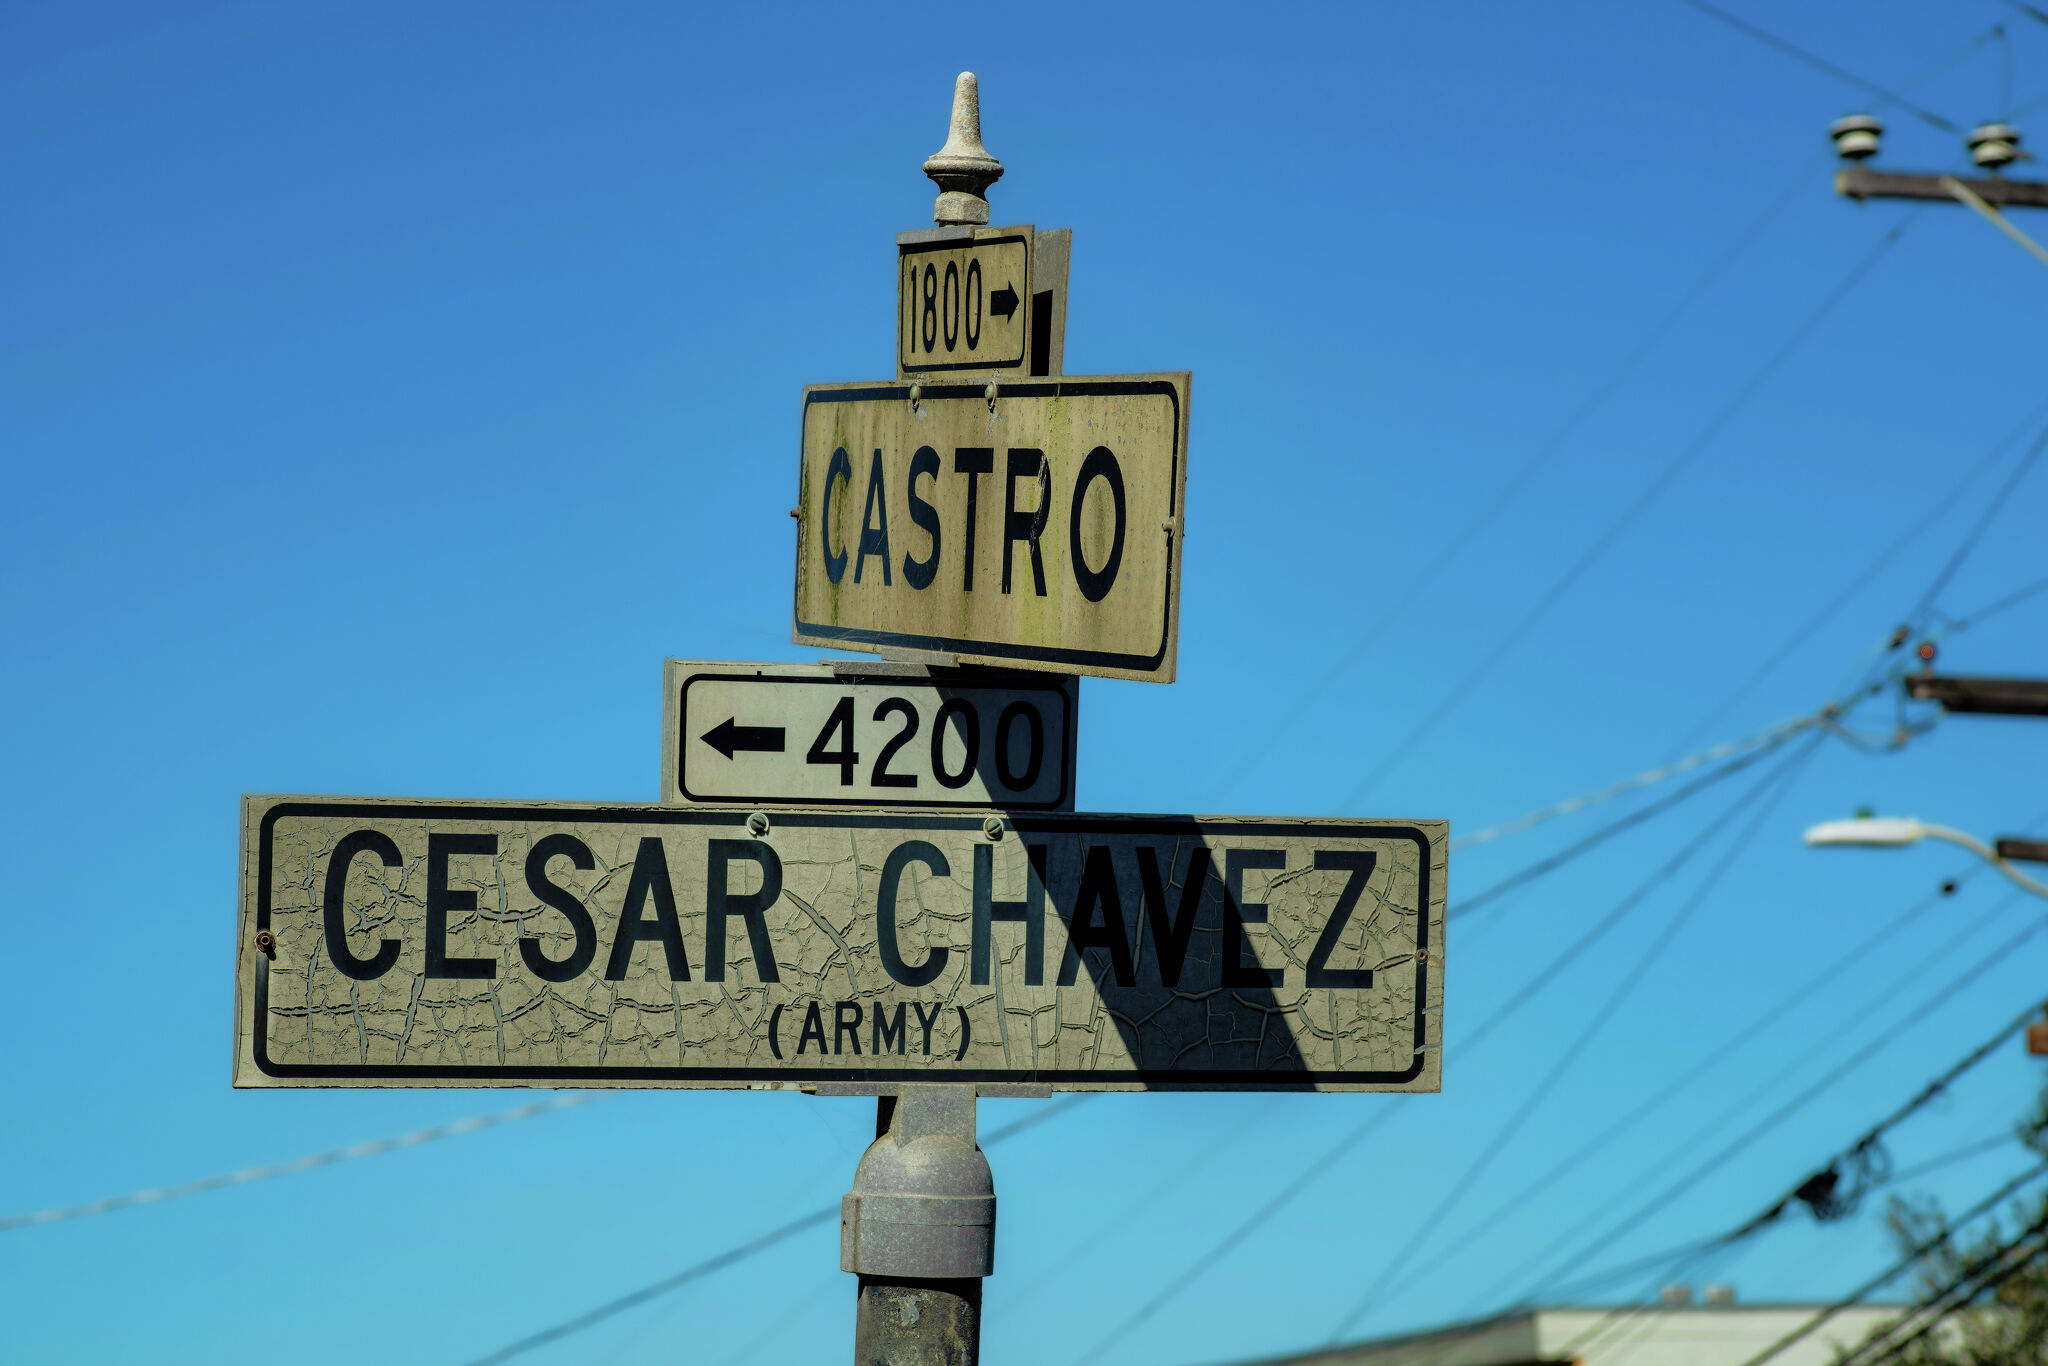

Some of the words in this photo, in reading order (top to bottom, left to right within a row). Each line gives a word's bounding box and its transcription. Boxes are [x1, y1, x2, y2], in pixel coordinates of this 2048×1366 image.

[910, 258, 982, 353] 1800
[822, 445, 1126, 602] CASTRO
[806, 696, 1045, 792] 4200
[323, 829, 783, 983] CESAR
[876, 840, 1377, 990] CHAVEZ
[768, 1001, 971, 1062] (ARMY)
